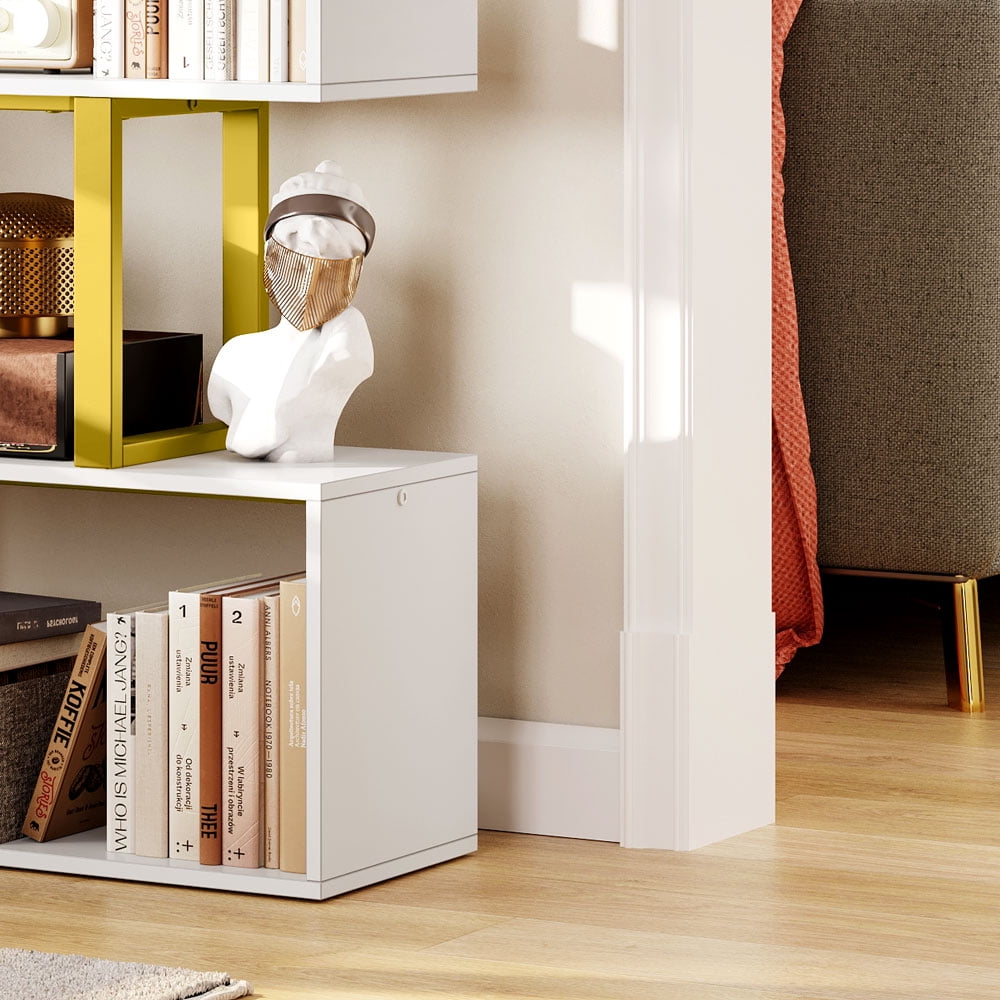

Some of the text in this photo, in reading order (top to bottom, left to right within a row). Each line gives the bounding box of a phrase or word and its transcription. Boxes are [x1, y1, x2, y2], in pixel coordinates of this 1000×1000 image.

[100, 5, 113, 62] JANG?
[126, 10, 145, 57] STORIES
[179, 604, 186, 618] 1
[231, 610, 243, 624] 2
[264, 604, 273, 661] ANNI ALBERS
[185, 657, 193, 687] Zmiana
[200, 641, 218, 685] PUUR
[53, 680, 87, 749] KOFFIE
[265, 680, 273, 729] NOTEBOOK
[114, 632, 127, 851] WHO IS MICHAEL JANG?
[35, 770, 57, 819] STORIES
[174, 754, 183, 812] do konstrukcji
[184, 758, 193, 810] Od dekoracji
[226, 747, 235, 793] przestrzeni
[235, 766, 245, 817] W labiryncie
[201, 804, 217, 839] THEE
[227, 798, 235, 835] obrazów
